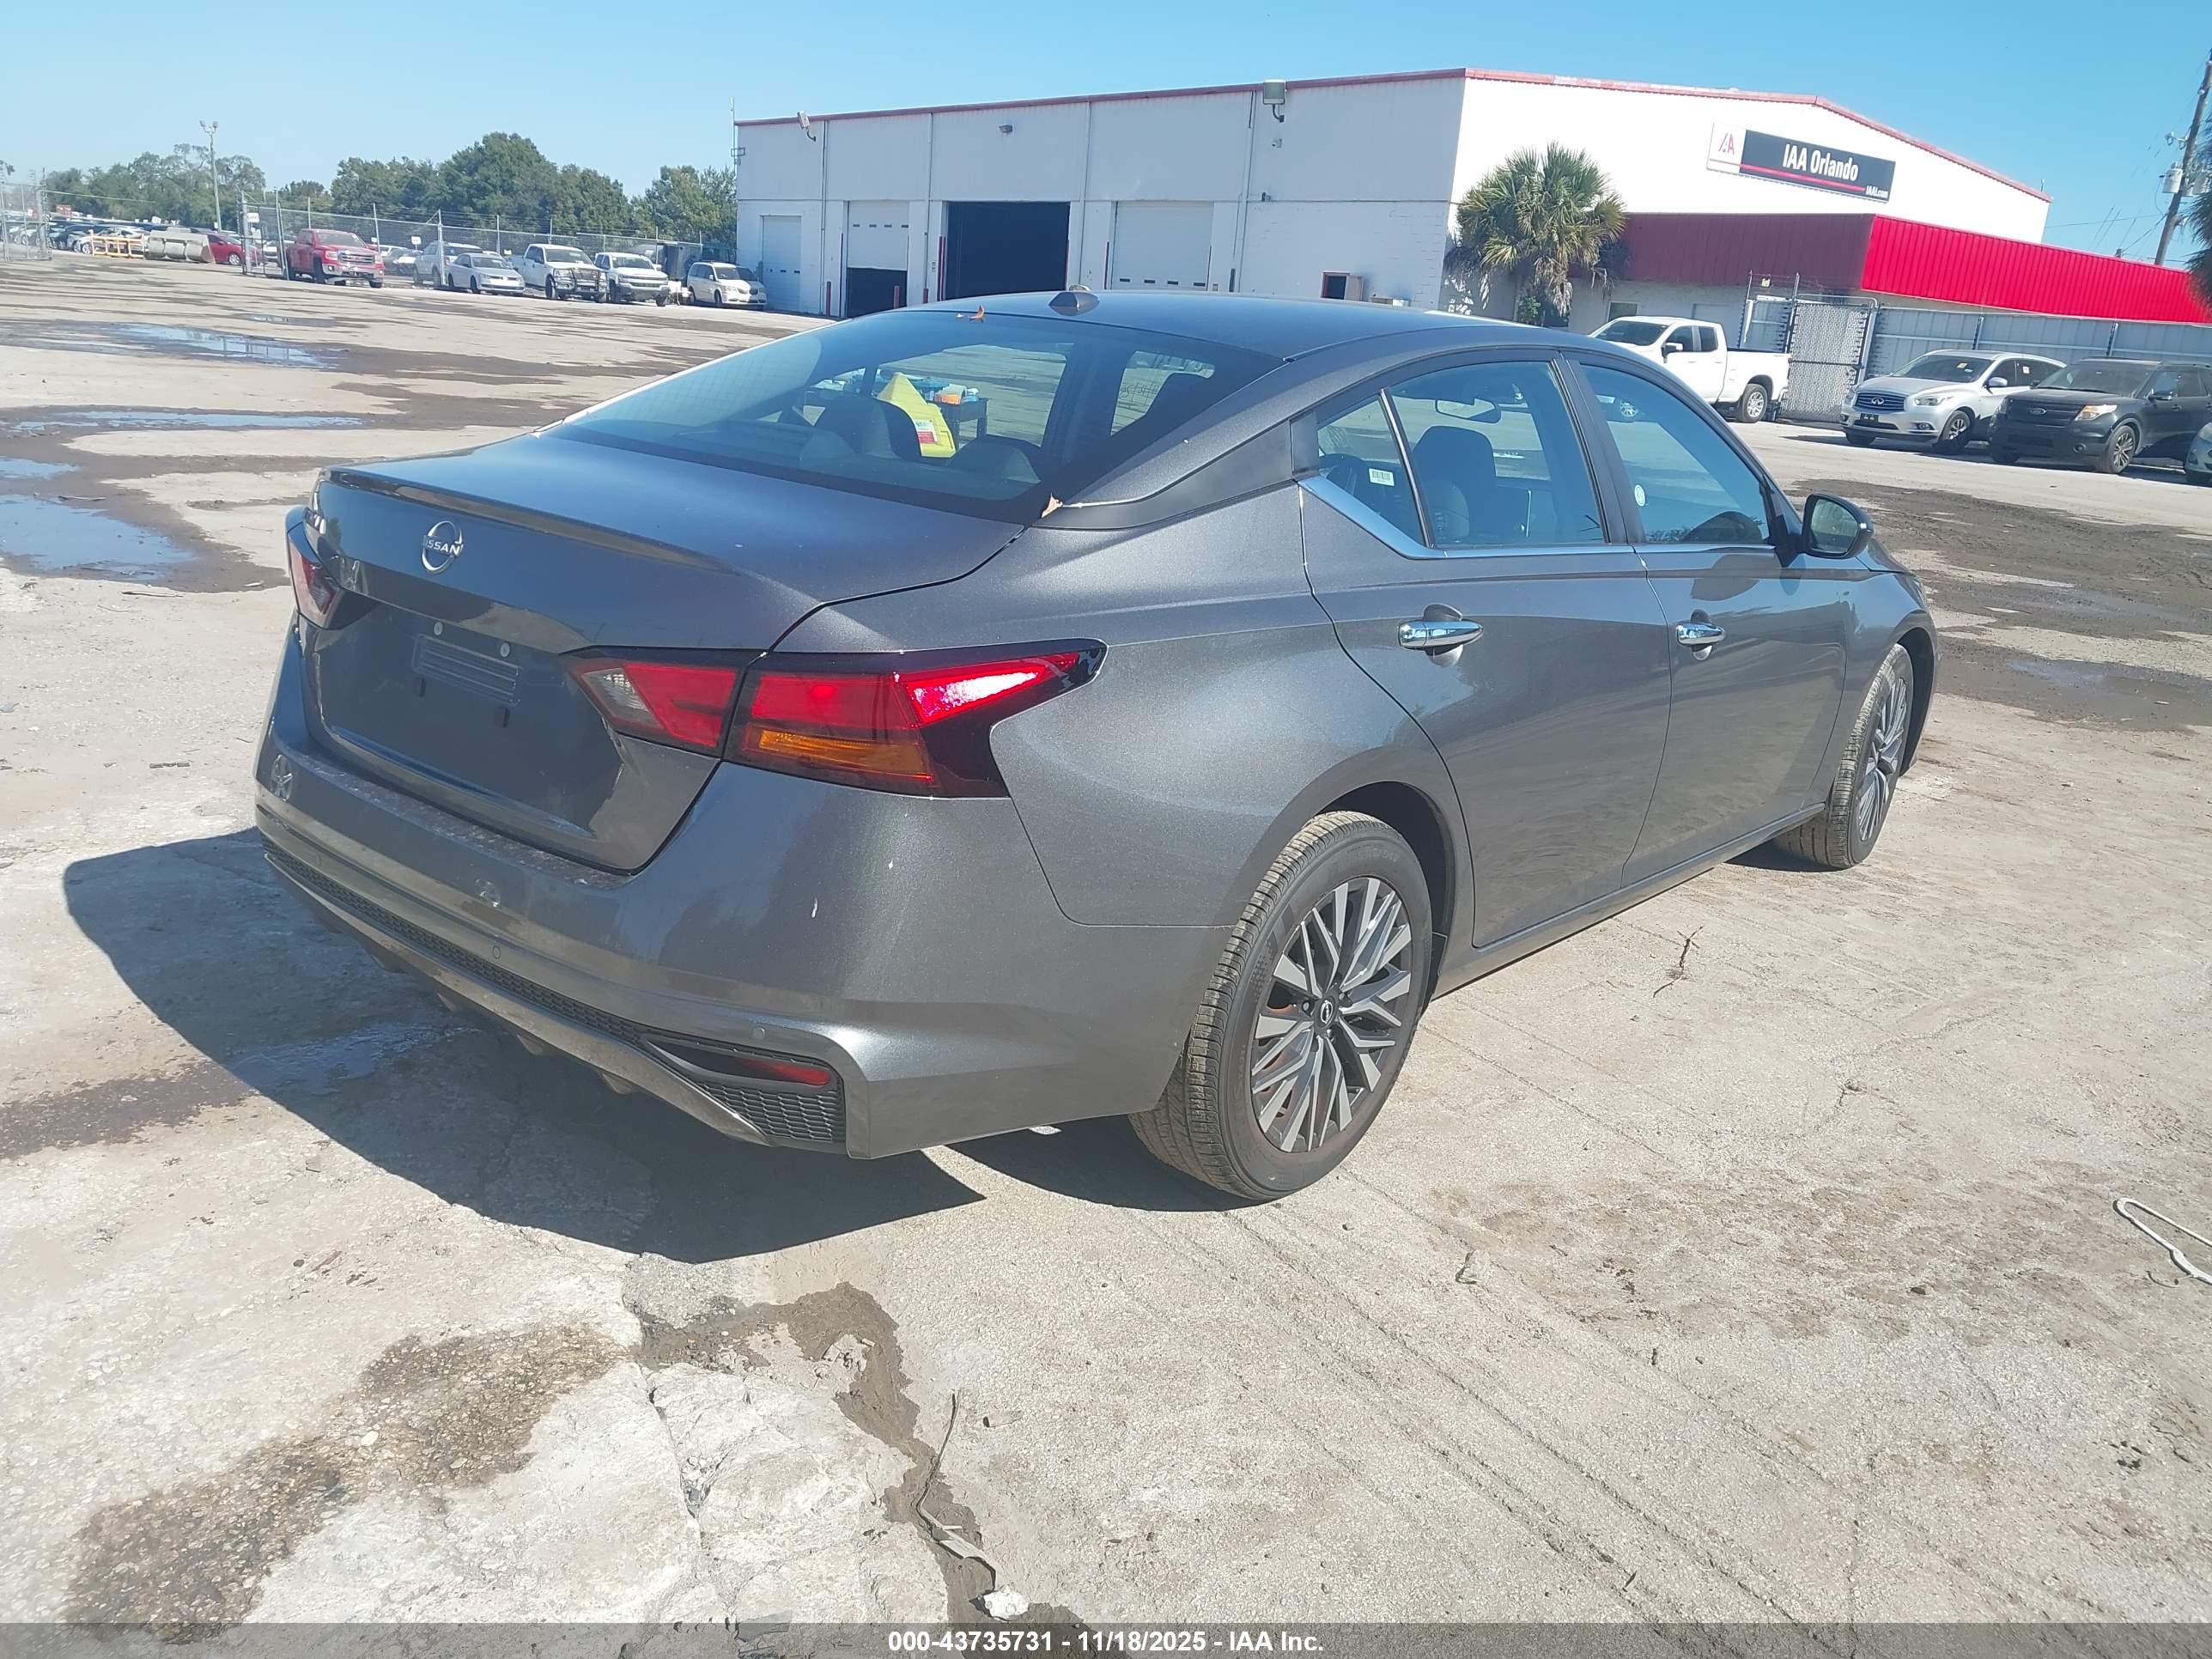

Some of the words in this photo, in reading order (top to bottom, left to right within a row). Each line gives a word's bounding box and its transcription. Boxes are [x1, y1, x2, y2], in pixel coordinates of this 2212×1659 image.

[1782, 143, 1808, 172] IAA
[1810, 149, 1859, 181] Orlando
[422, 535, 465, 557] ISSAN
